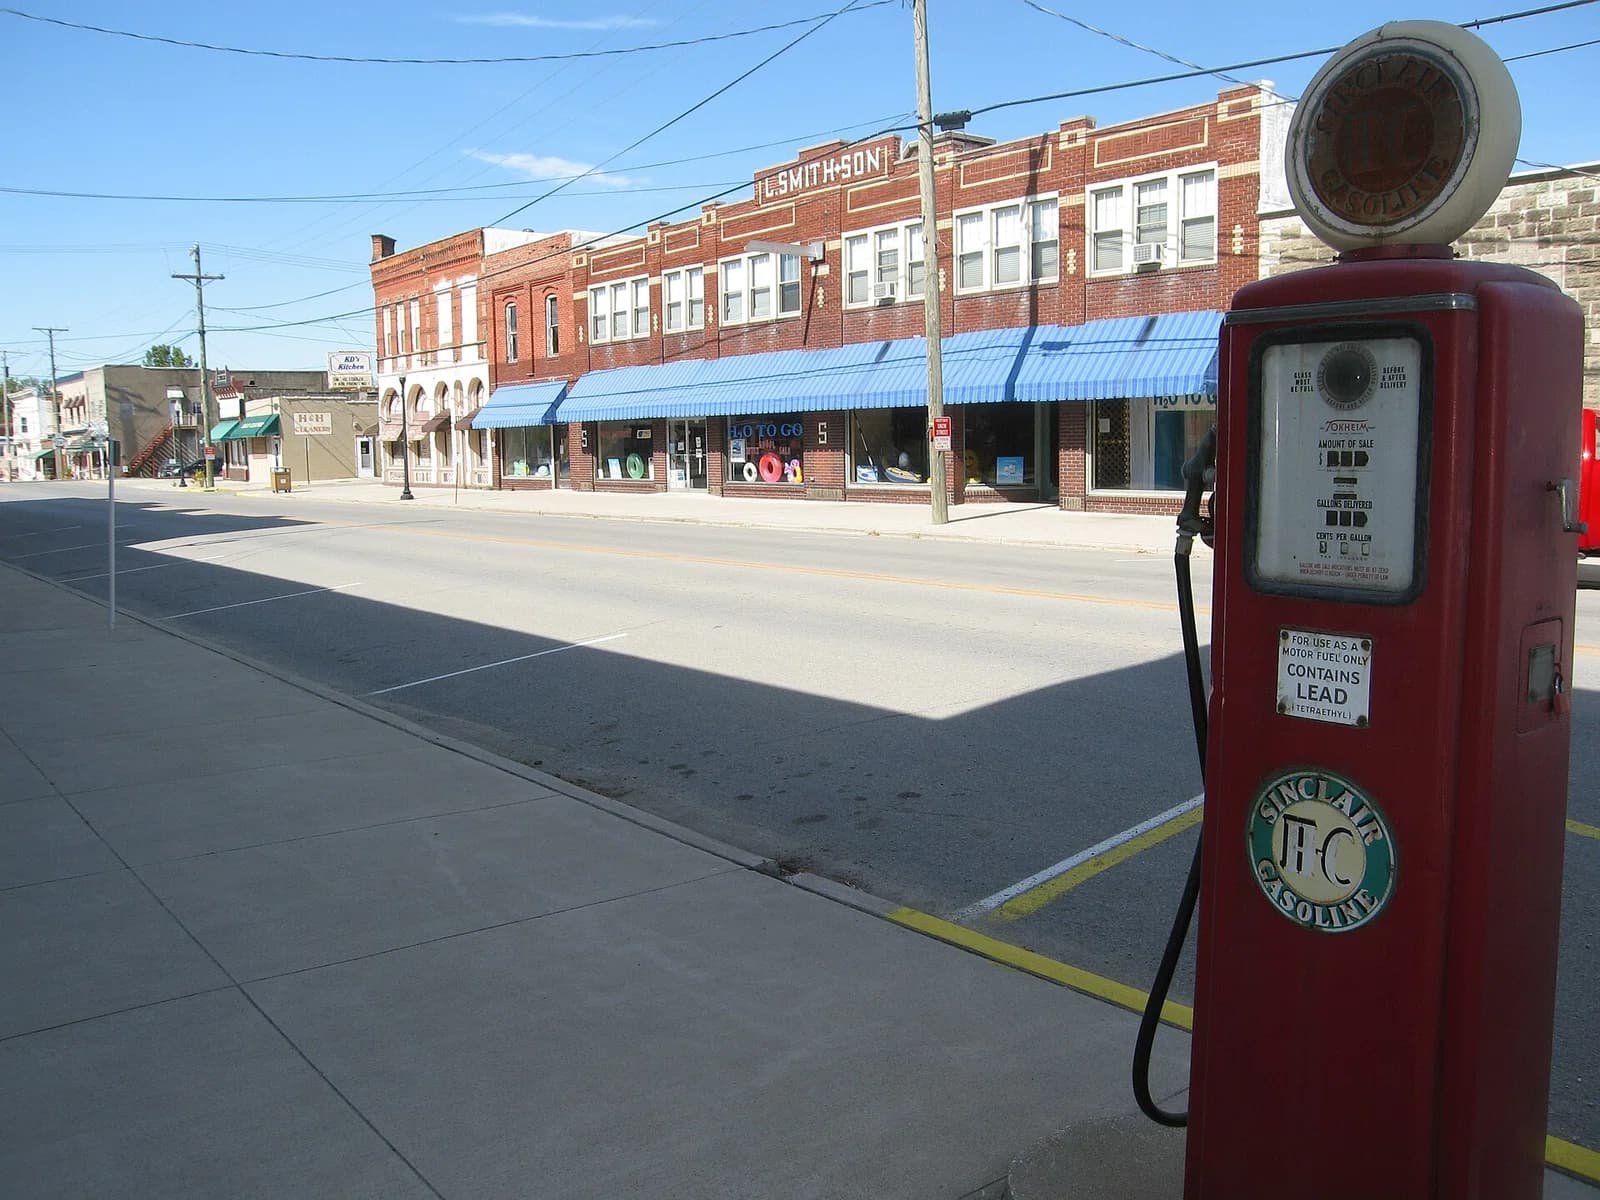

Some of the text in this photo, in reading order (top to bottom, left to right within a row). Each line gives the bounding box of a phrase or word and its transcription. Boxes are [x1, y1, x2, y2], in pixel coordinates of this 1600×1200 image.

[1294, 371, 1312, 379] GLASS
[1383, 366, 1405, 374] BEFORE
[1380, 381, 1407, 389] DELIVERY
[757, 423, 777, 437] TO
[780, 422, 804, 437] GO
[1326, 419, 1370, 432] TOKHEIM
[1318, 440, 1374, 449] AMOUNT OF SALE
[1317, 499, 1373, 510] GALLONS DELIVERED
[1316, 532, 1372, 542] CENTS PER GALLON
[1292, 635, 1358, 651] FOR USE AS A
[1282, 647, 1368, 666] MOTOR FUEL ONLY
[1287, 663, 1360, 685] CONTAINS
[1297, 682, 1348, 705] LEAD
[1258, 777, 1383, 846] SINCLAIR
[1257, 858, 1379, 927] GASOLINE
